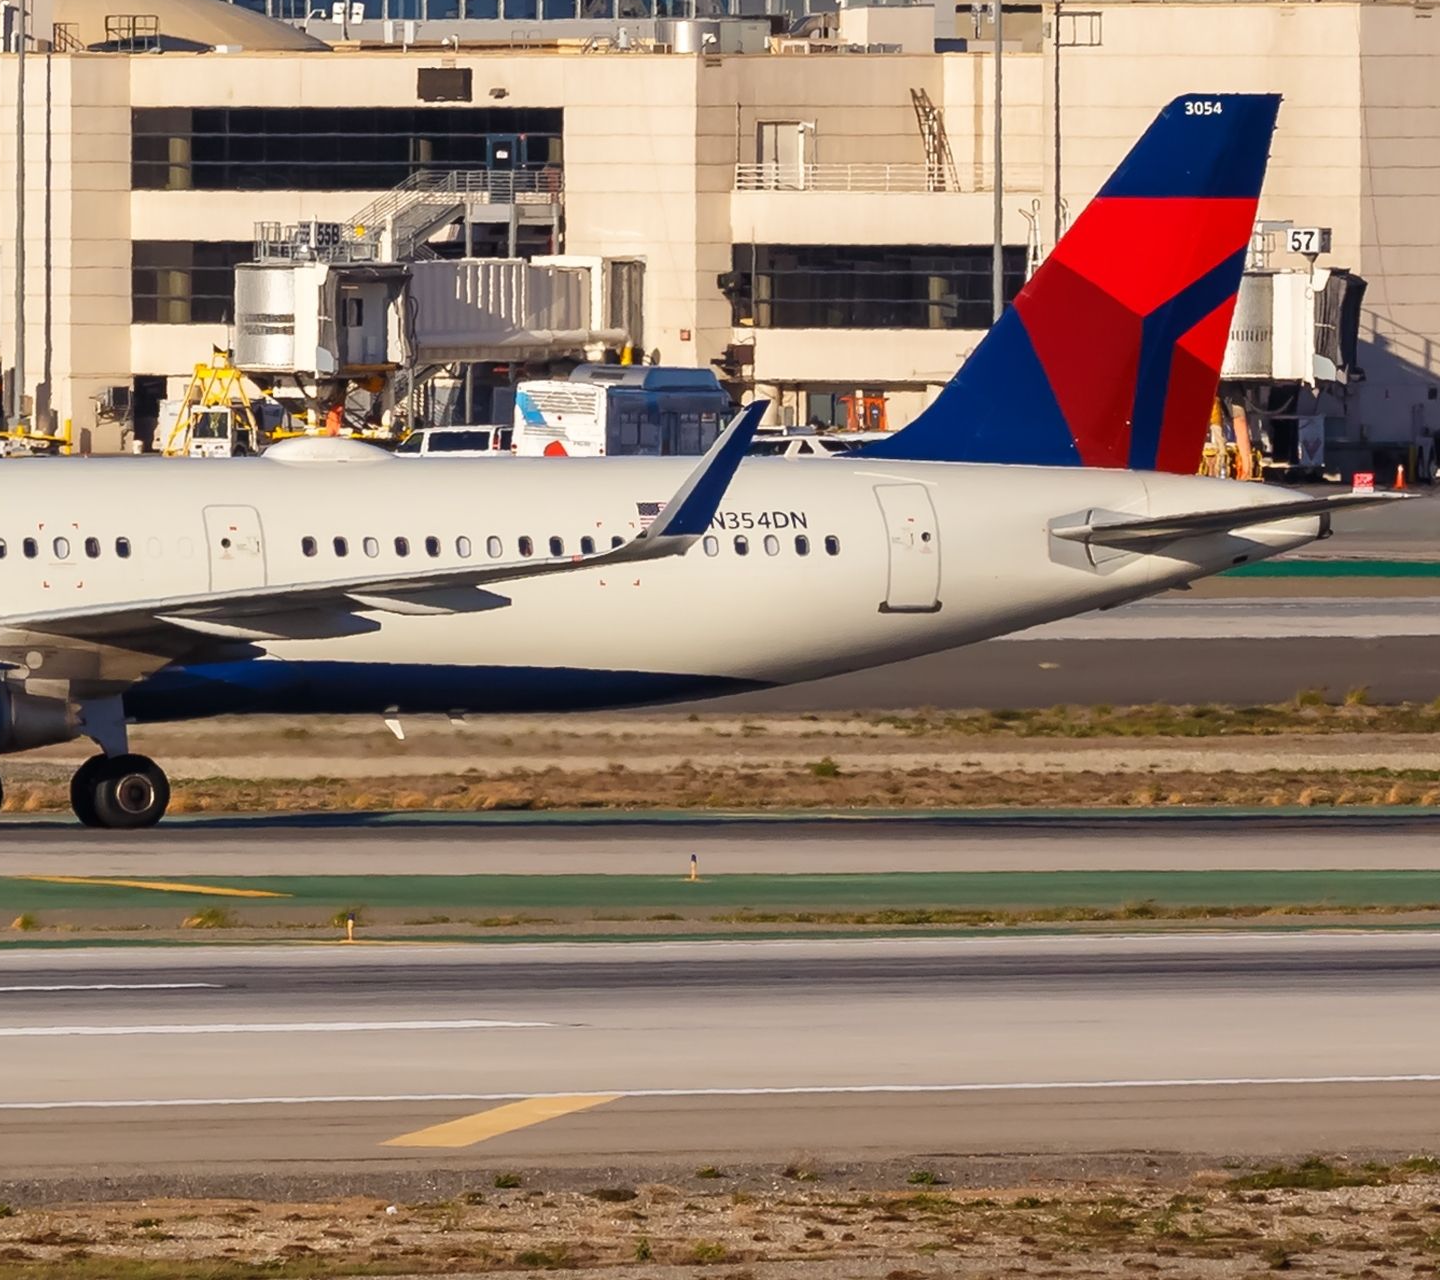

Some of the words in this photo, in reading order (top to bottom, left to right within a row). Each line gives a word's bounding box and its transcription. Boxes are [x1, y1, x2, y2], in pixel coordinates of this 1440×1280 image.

[1185, 101, 1223, 115] 3054
[1291, 231, 1315, 252] 57
[710, 511, 808, 530] N354DN
